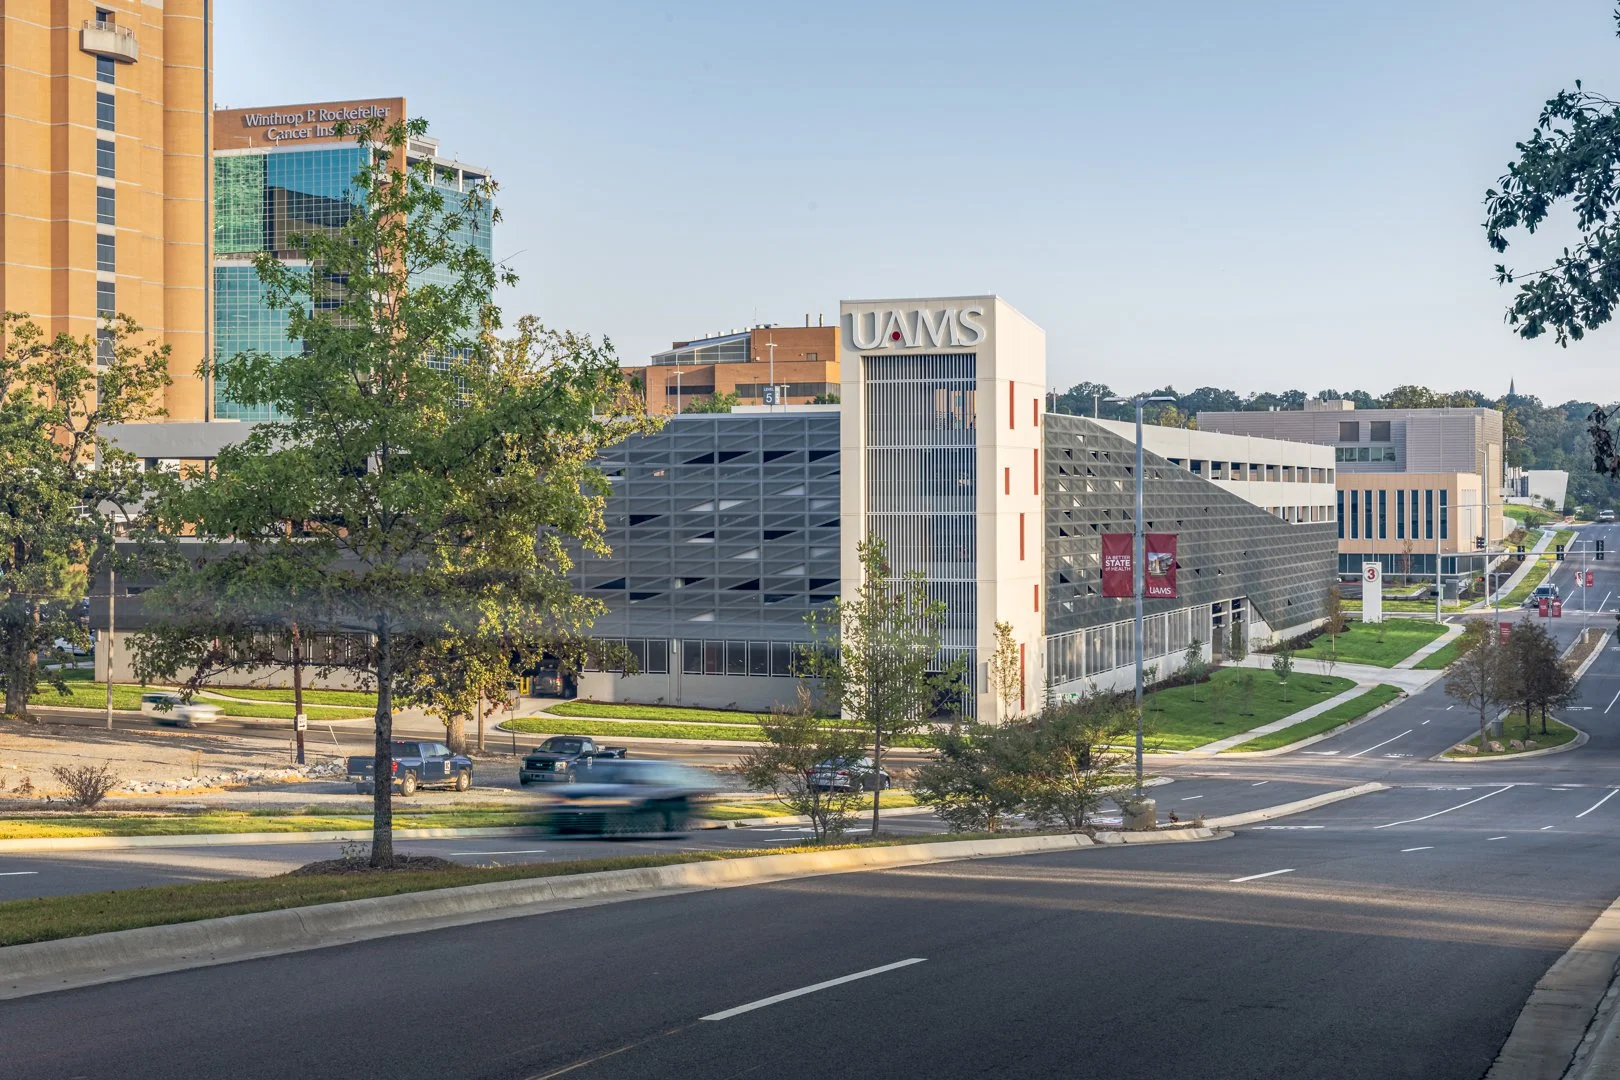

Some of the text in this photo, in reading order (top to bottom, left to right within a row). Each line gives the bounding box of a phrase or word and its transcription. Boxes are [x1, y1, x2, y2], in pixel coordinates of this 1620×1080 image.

[245, 105, 390, 127] Winthrop P. Rockefeller
[267, 126, 312, 141] Cancer
[851, 306, 987, 350] UAMS
[766, 393, 773, 403] 5
[1105, 559, 1131, 567] STATE
[1367, 569, 1375, 580] 3
[1149, 586, 1172, 595] UAMS
